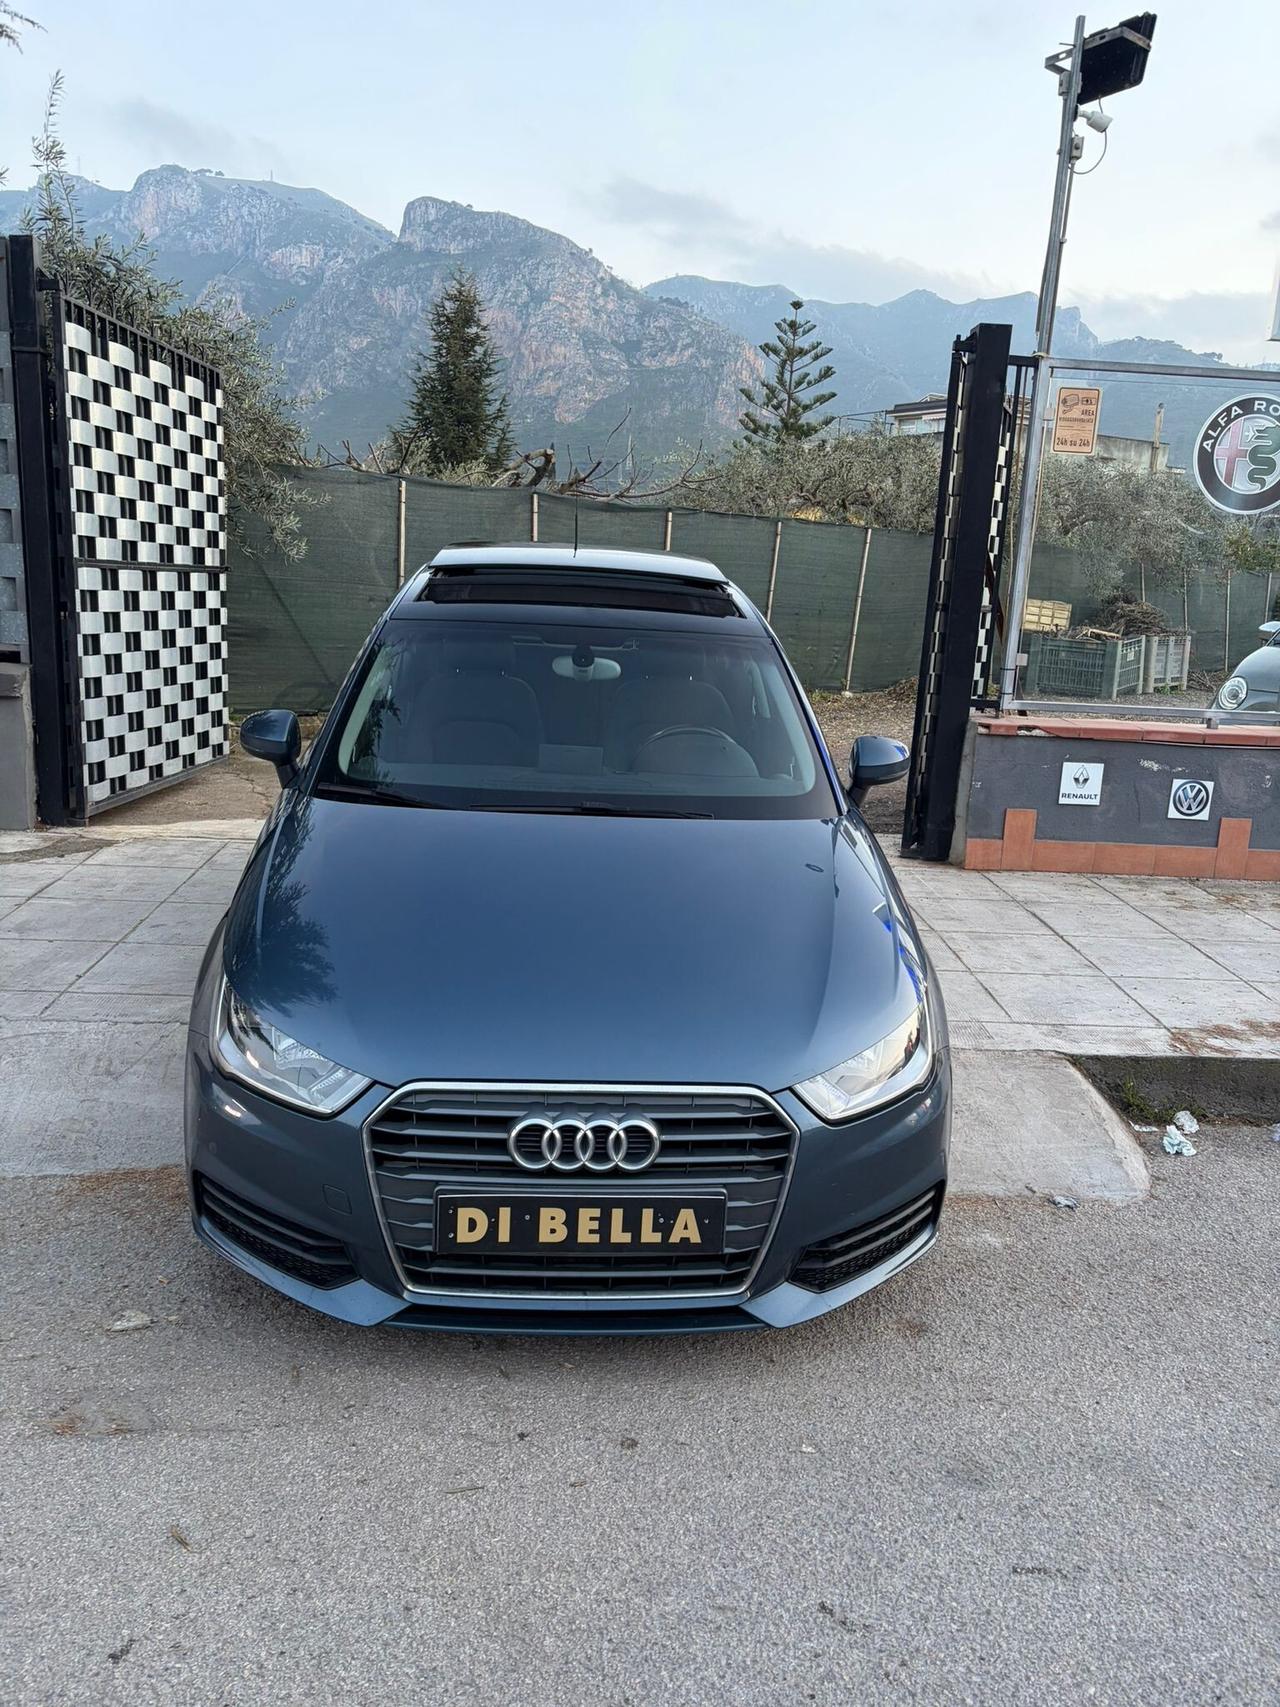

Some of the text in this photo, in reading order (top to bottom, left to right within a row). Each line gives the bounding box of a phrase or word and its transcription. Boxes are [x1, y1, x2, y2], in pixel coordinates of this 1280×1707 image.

[1202, 405, 1243, 453] ALFA
[1056, 437, 1068, 446] 24h
[1078, 438, 1091, 447] 24h
[1061, 792, 1098, 801] RENAULT
[456, 1207, 702, 1244] DI BELLA
